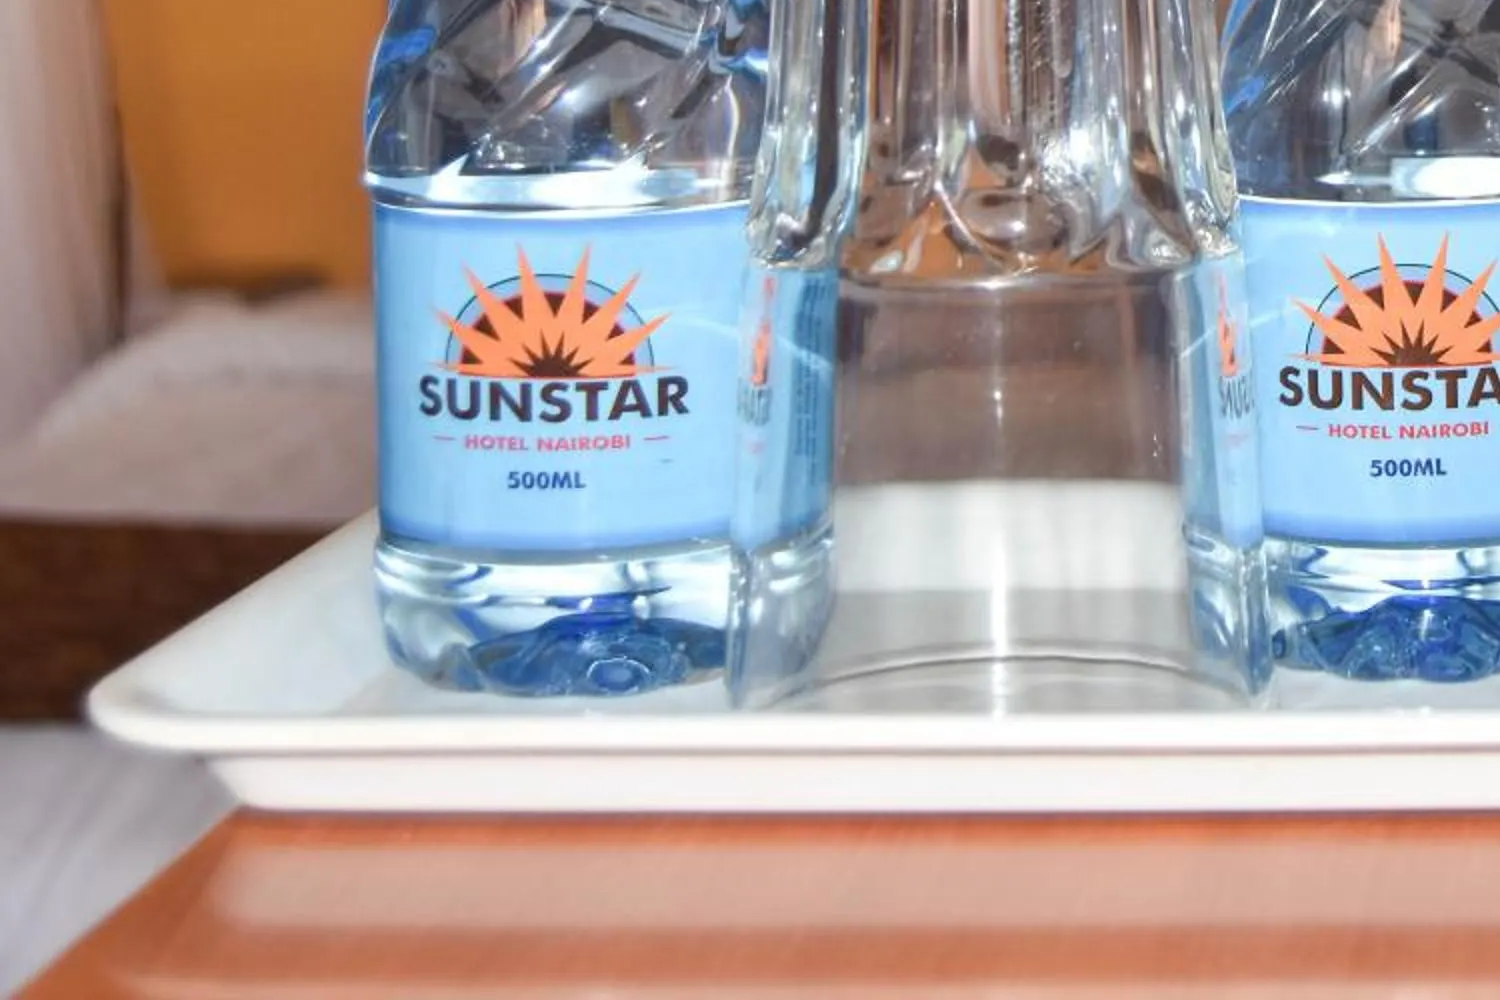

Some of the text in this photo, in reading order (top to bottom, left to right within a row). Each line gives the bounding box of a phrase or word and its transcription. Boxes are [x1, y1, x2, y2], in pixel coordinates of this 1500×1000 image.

[418, 373, 690, 423] SUNSTAR
[1328, 420, 1490, 440] HOTEL NAIROBI
[464, 434, 631, 452] HOTEL NAIROBI
[1369, 457, 1447, 478] 500ML
[507, 470, 587, 491] 500ML
